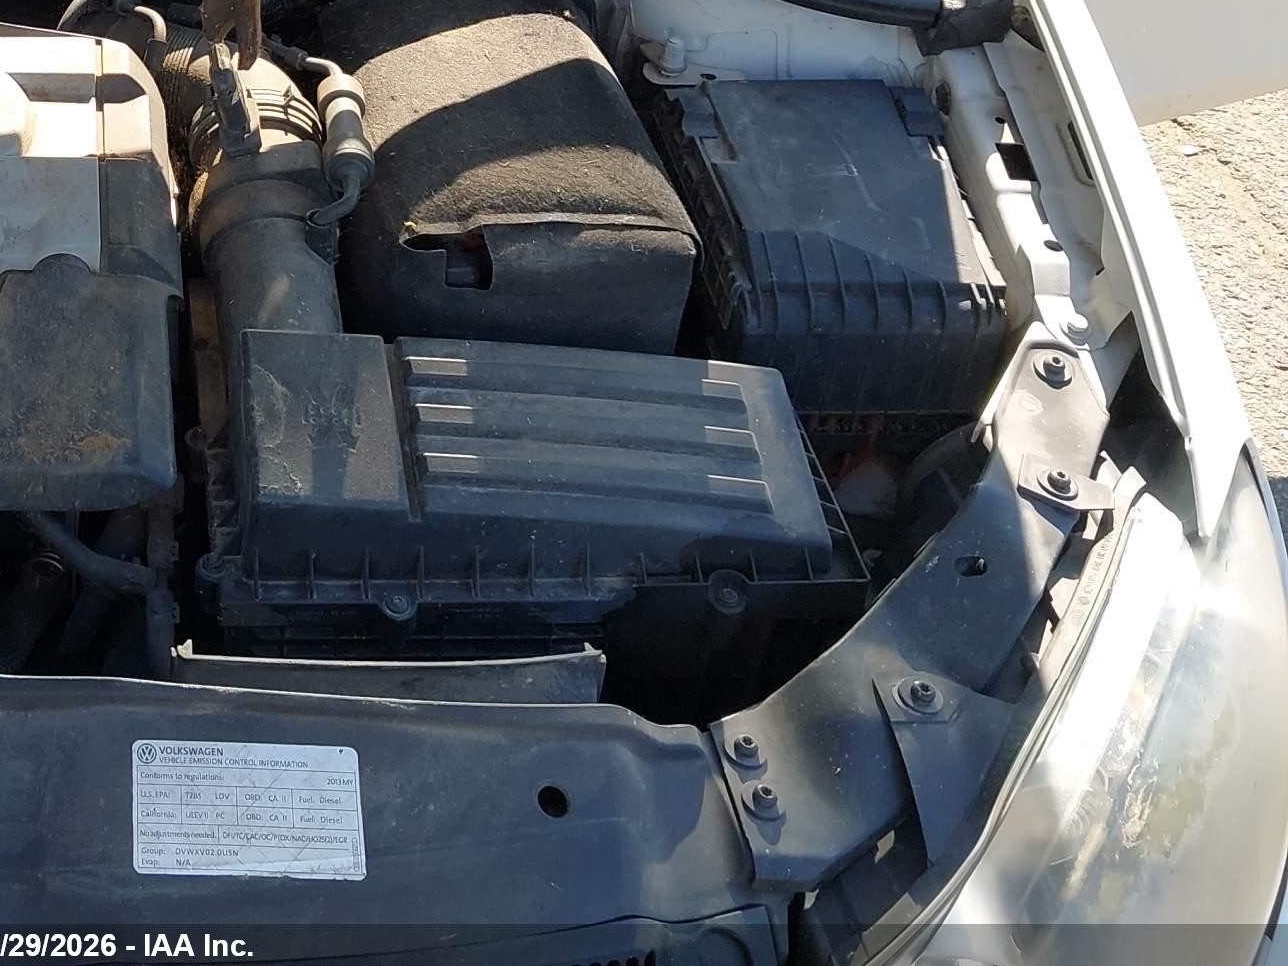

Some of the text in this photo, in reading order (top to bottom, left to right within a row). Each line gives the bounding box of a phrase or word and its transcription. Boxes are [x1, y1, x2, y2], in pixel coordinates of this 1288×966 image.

[158, 746, 224, 756] VOLKSWAGEN
[158, 756, 308, 768] VEHICLE EMISSION CONTROL INFORMATION
[140, 772, 172, 780] Conforms
[184, 772, 225, 783] regulations:
[141, 847, 166, 856] Group:
[141, 858, 160, 866] Evap:
